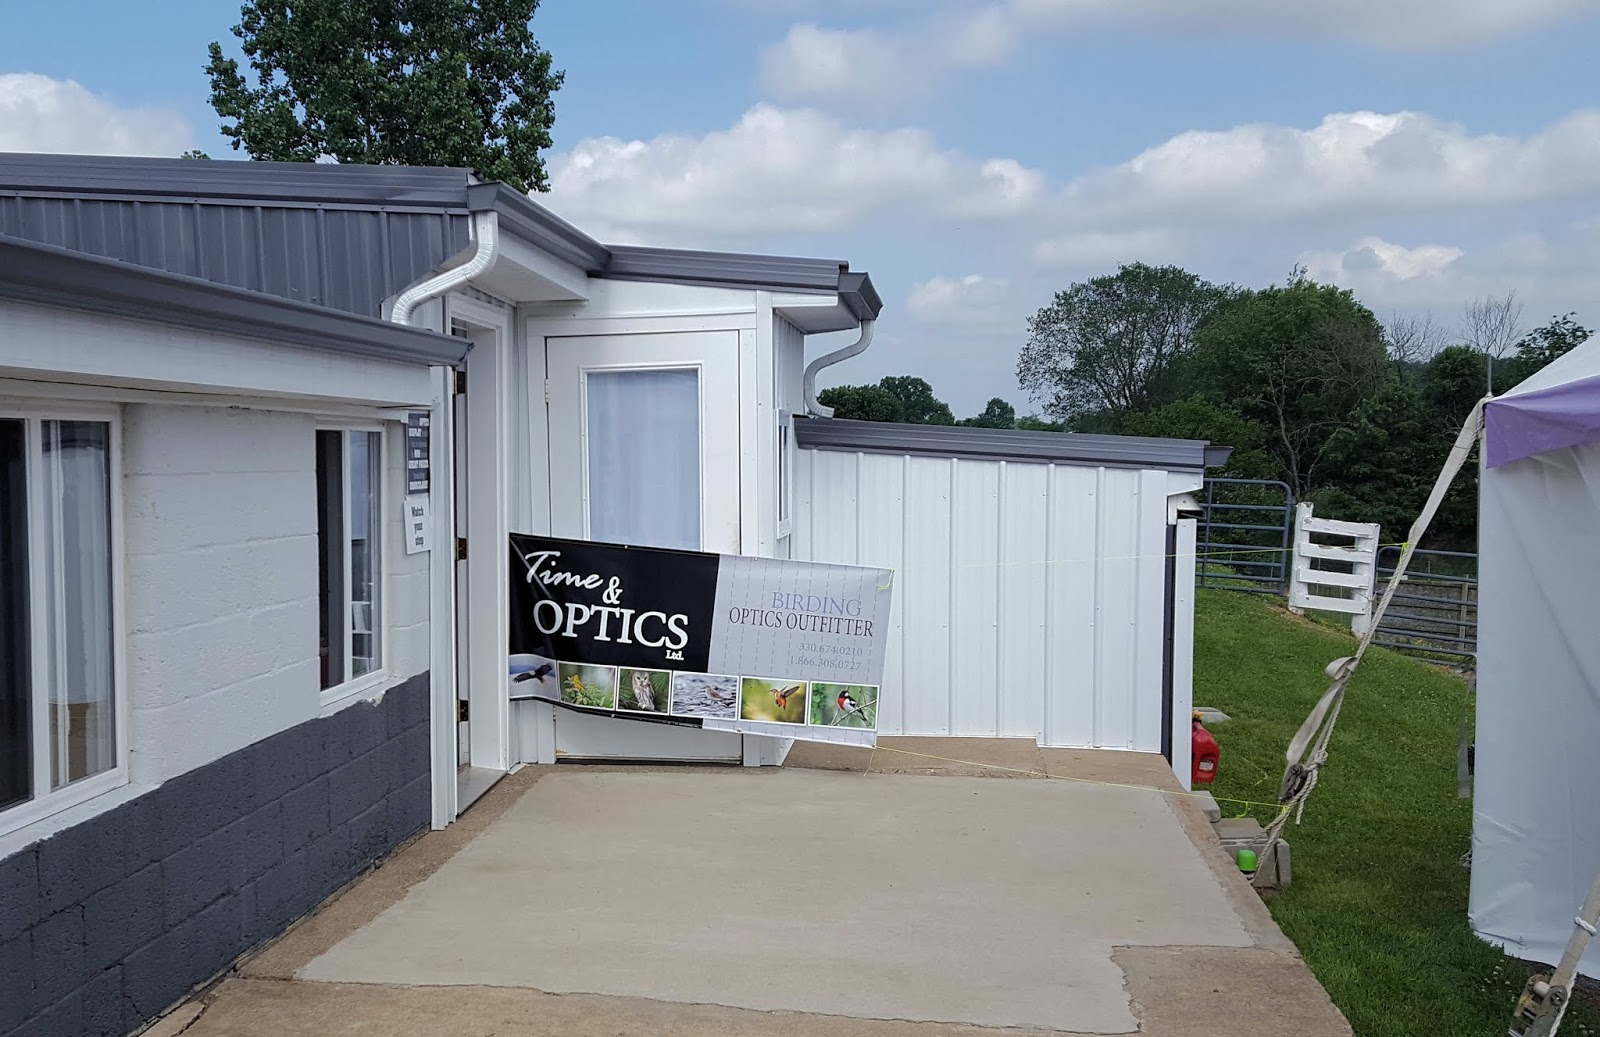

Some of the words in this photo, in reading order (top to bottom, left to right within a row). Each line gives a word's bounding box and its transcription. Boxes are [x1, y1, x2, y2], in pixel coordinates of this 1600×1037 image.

[524, 551, 604, 589] Time
[602, 576, 623, 604] &
[771, 591, 862, 617] BIRDING
[533, 599, 689, 650] OPTICS
[729, 606, 783, 629] OPTICS
[786, 612, 873, 637] OUTFITTER
[665, 650, 684, 661] Ltd.
[789, 656, 862, 670] 1.866.308.0727
[799, 642, 863, 657] 330.674.0210
